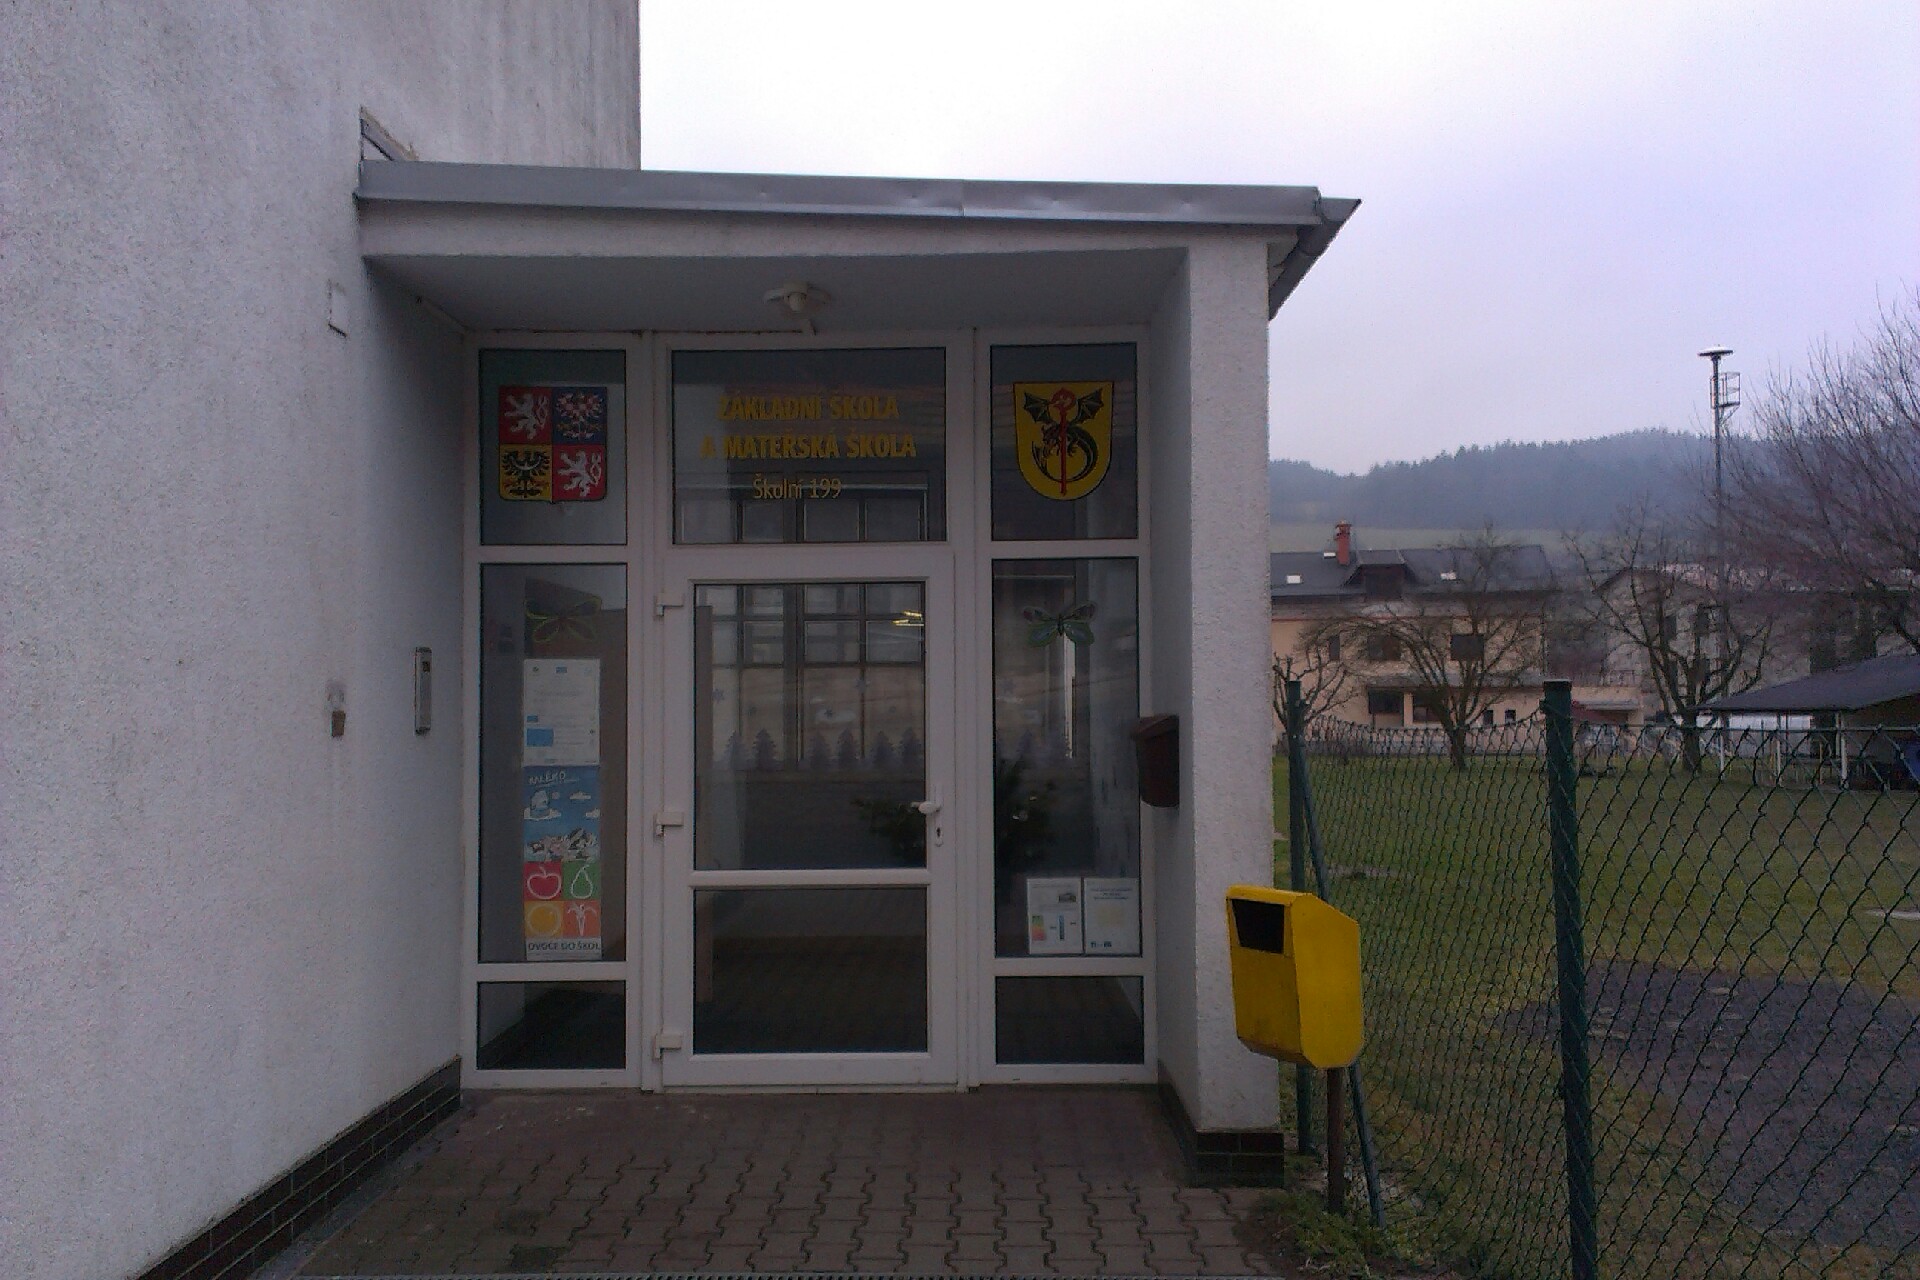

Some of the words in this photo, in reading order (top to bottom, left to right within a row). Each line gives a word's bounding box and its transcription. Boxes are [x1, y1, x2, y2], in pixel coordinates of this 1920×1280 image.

[700, 435, 716, 458] A
[723, 428, 840, 458] MATEŘSKÁ
[846, 428, 917, 458] ŠKOLA
[752, 473, 804, 499] Školní
[809, 478, 842, 499] 199
